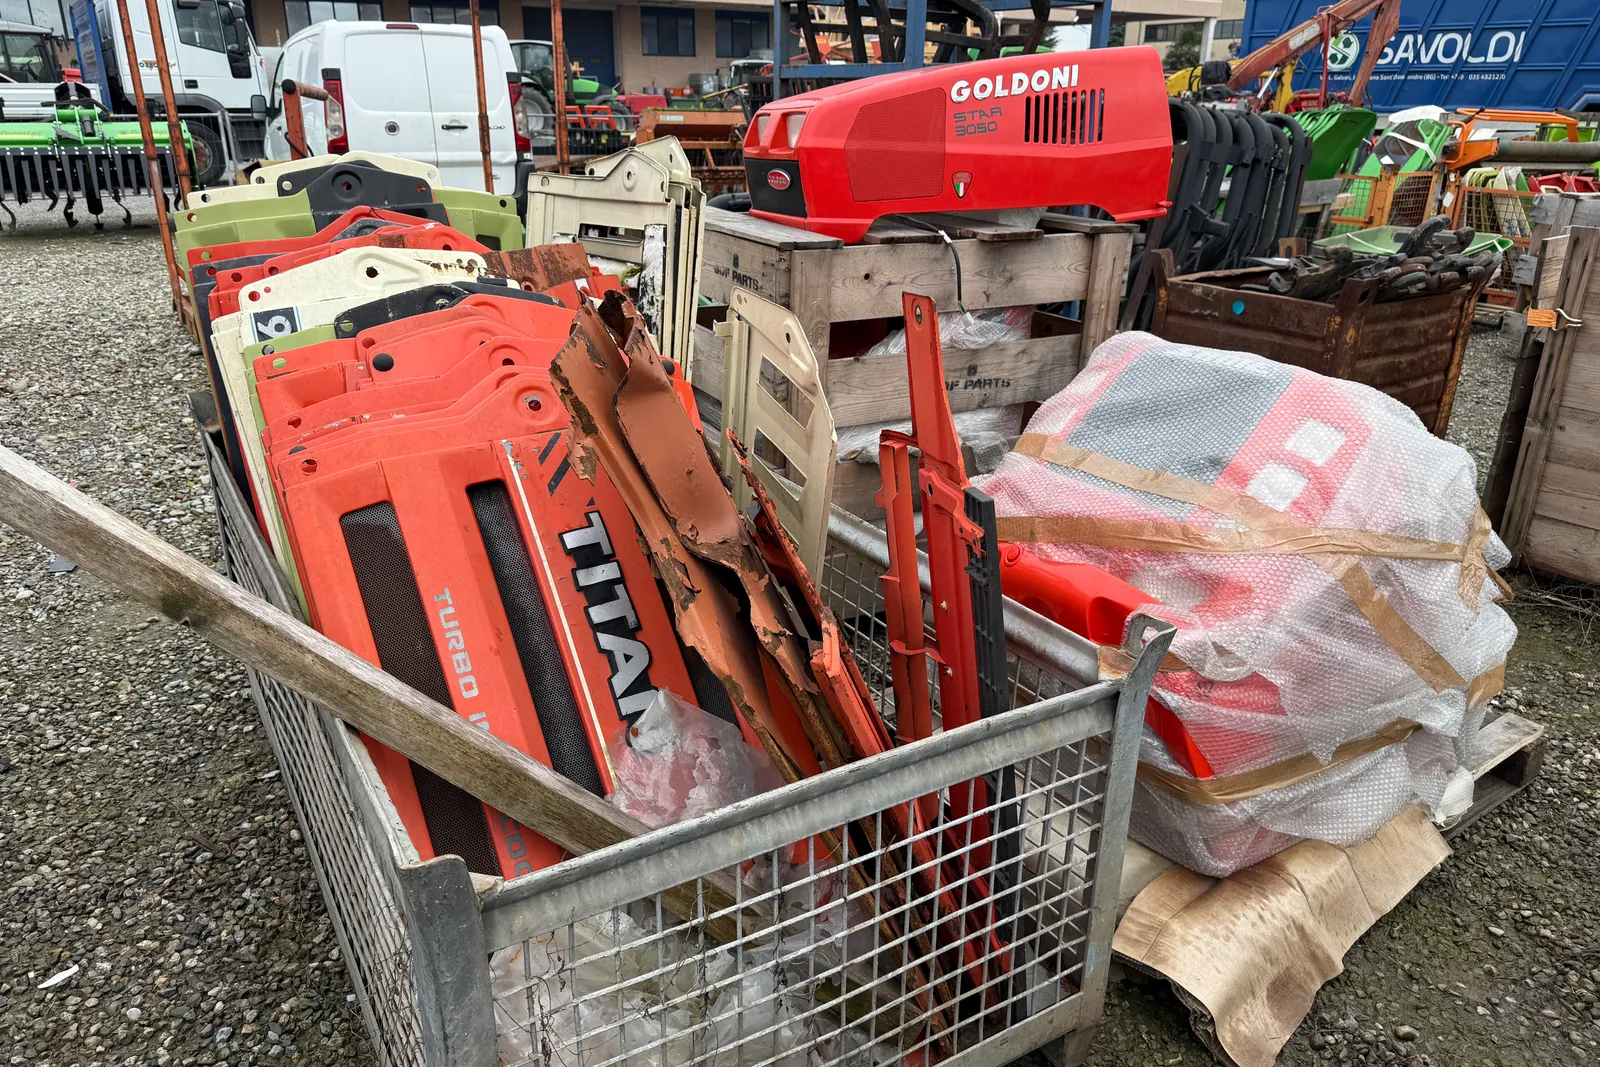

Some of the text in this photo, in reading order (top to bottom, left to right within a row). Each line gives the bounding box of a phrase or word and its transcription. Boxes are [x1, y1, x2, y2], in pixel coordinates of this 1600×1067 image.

[1375, 30, 1527, 65] SAVOLDI
[950, 64, 1079, 104] GOLDONI
[953, 107, 1003, 123] STAR
[955, 121, 999, 137] 3050
[731, 269, 759, 291] PARTS
[944, 377, 1012, 391] DF PARTS
[434, 586, 479, 699] TURBO
